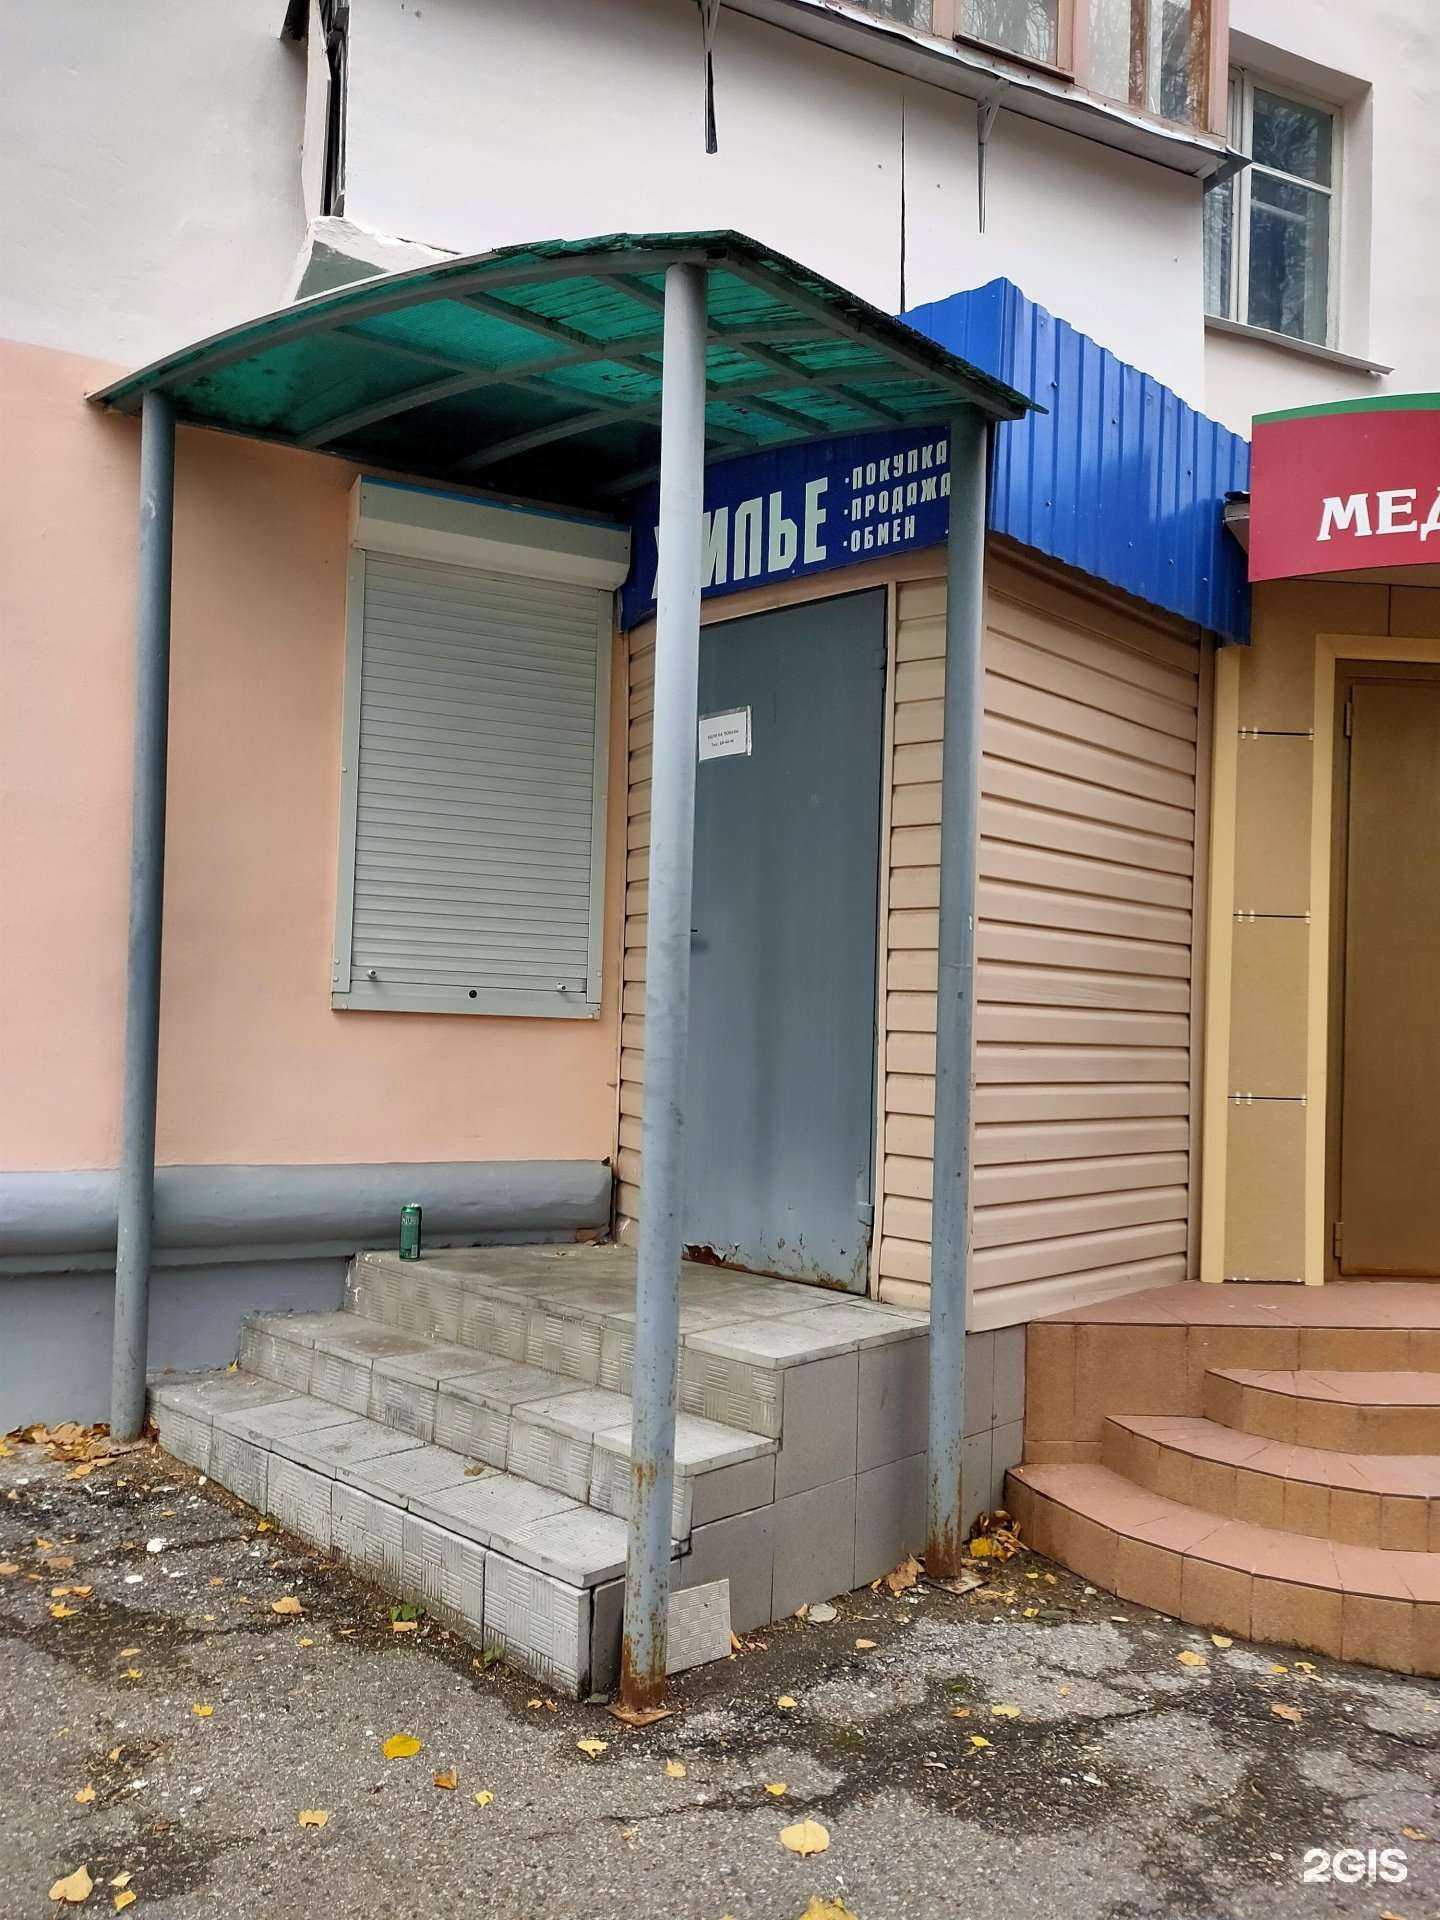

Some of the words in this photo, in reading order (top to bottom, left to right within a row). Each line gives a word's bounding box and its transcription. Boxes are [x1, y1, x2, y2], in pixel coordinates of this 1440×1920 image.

[852, 439, 948, 490] ПОКУПКА
[851, 472, 951, 521] ПРОДАЖА
[651, 476, 829, 600] ИЛЬЕ
[851, 515, 916, 552] ОБМЕН
